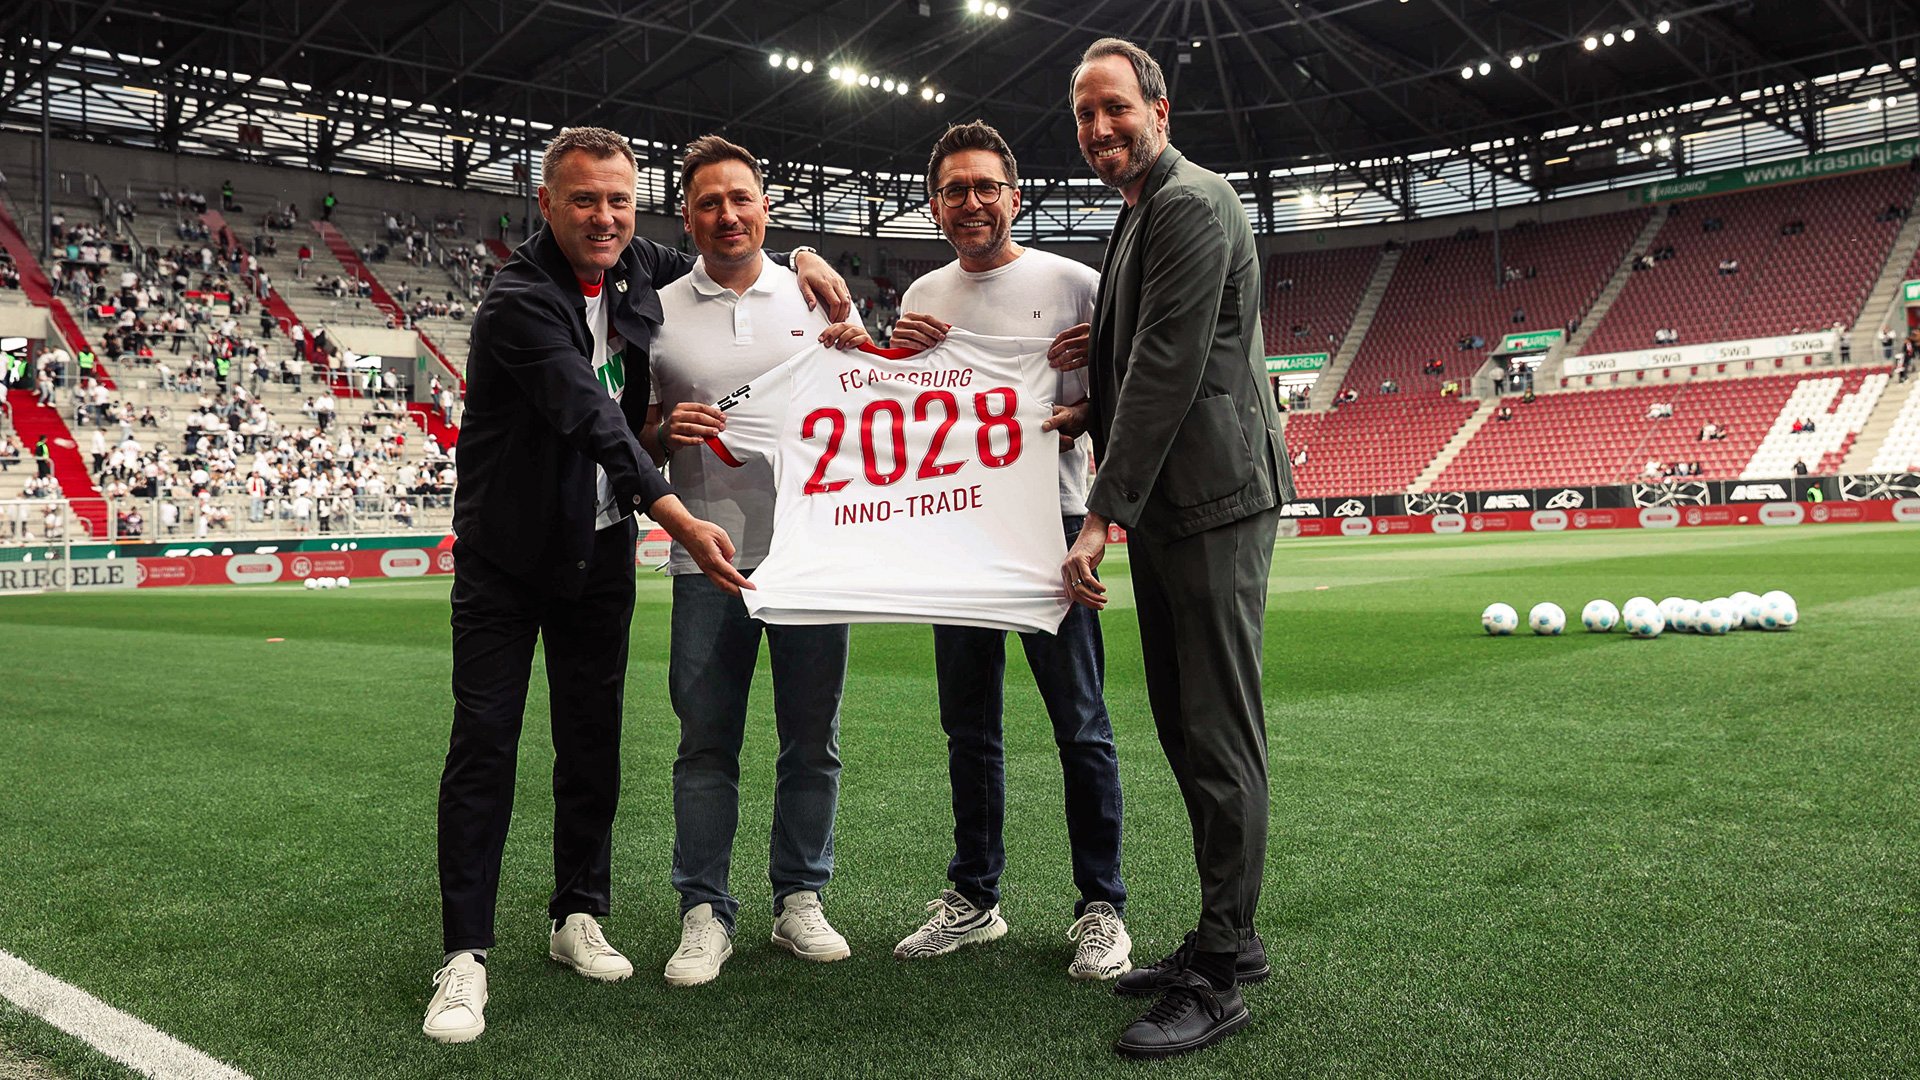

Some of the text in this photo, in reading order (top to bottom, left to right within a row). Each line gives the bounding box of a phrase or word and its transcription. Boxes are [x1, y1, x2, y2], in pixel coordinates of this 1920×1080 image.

[1033, 310, 1041, 319] H
[1588, 339, 1824, 371] swa swa swa swa
[838, 368, 863, 393] FC
[800, 386, 1024, 497] 2028
[834, 484, 983, 526] INNO-TRADE
[0, 565, 125, 589] RIEGELE
